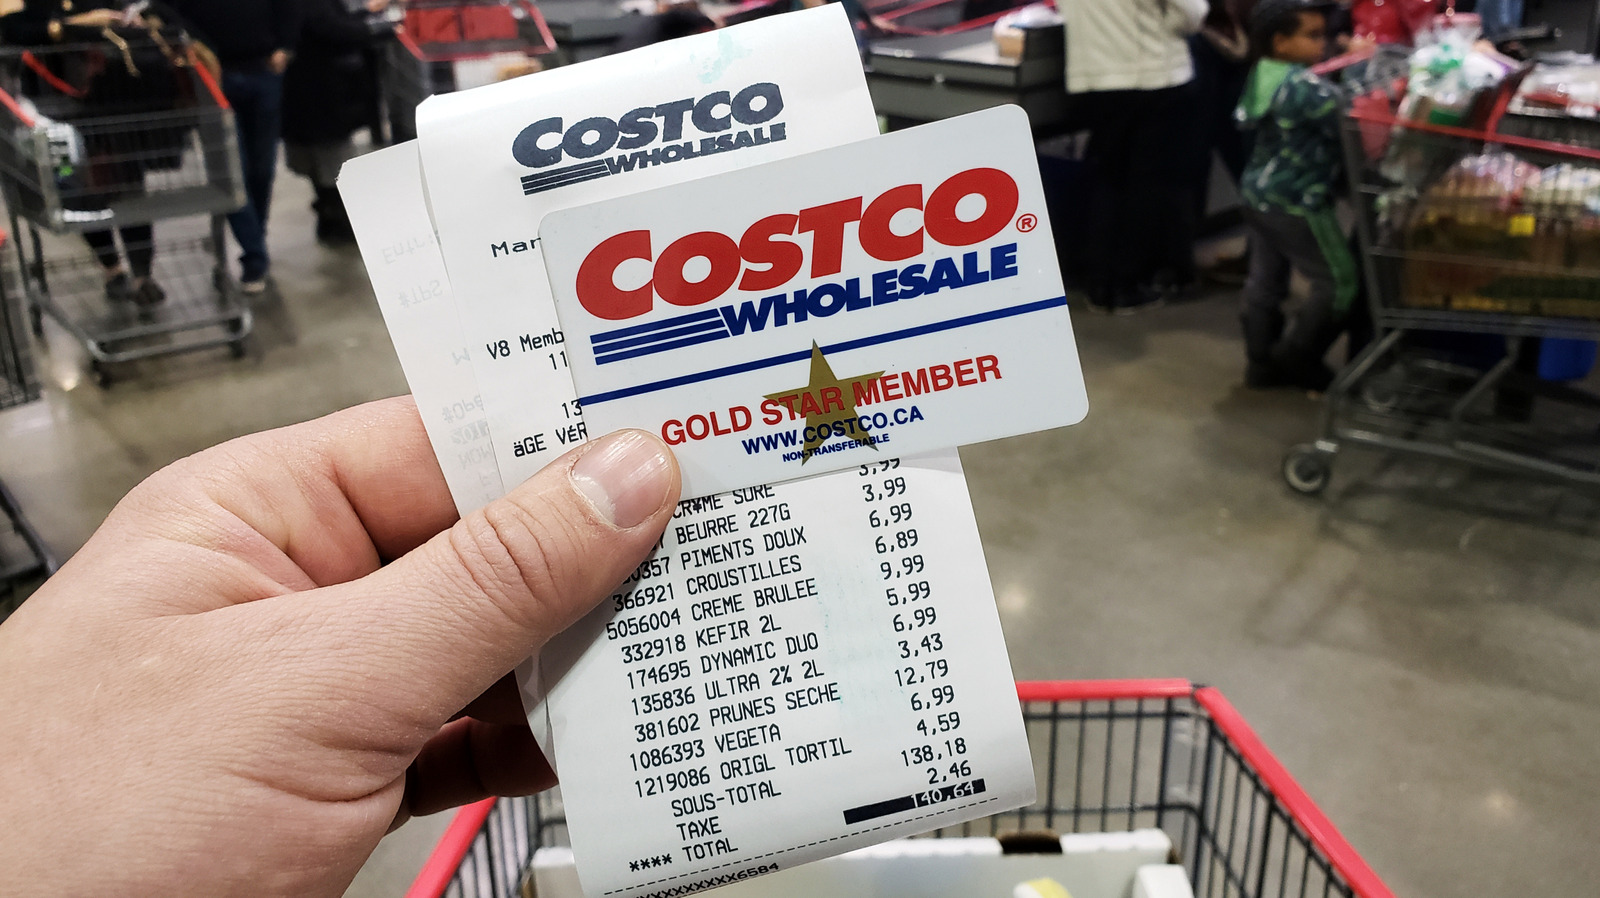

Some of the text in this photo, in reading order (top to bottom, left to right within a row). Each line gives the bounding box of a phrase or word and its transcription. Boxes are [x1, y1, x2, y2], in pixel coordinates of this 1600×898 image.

[512, 82, 784, 168] COSTCO
[604, 122, 787, 175] WHOLESALE
[576, 167, 1019, 320] COSTCO
[720, 243, 1018, 336] WHOLESALE
[486, 340, 510, 360] V8
[661, 354, 1002, 446] GOLD STAR MEMBER
[741, 405, 924, 455] WWW.COSTCO.CA
[782, 433, 890, 463] NON-TRANSFERABLE
[676, 514, 738, 545] BEURRE
[748, 503, 791, 528] 227G
[862, 476, 906, 502] 3,99
[732, 484, 775, 505] SURE
[613, 529, 919, 612] 366921 CROUSTILLES 6,89
[681, 538, 755, 570] PIMENTS
[763, 526, 807, 552] DOUX
[869, 503, 912, 528] 6,99
[606, 554, 925, 640] 5056004 CREME BRULEE 9,99
[621, 580, 931, 663] 332918 KEFIR 2L 5,99
[627, 606, 937, 689] 174695 DYNAMIC DUO 6,99
[631, 632, 943, 716] 135836 ULTRA 2% 2L 3,43
[629, 685, 955, 772] 1086393 VEGETA 6,99
[634, 658, 949, 743] 381602 PRUNES SECHE 12,79
[634, 711, 961, 798] 1219086 ORIGL TORTIL 4,59
[671, 737, 967, 817] SOUS-TOTAL 138,18
[676, 760, 972, 841] TAXE 2,46
[682, 838, 739, 862] TOTAL
[910, 782, 975, 808] 140,64
